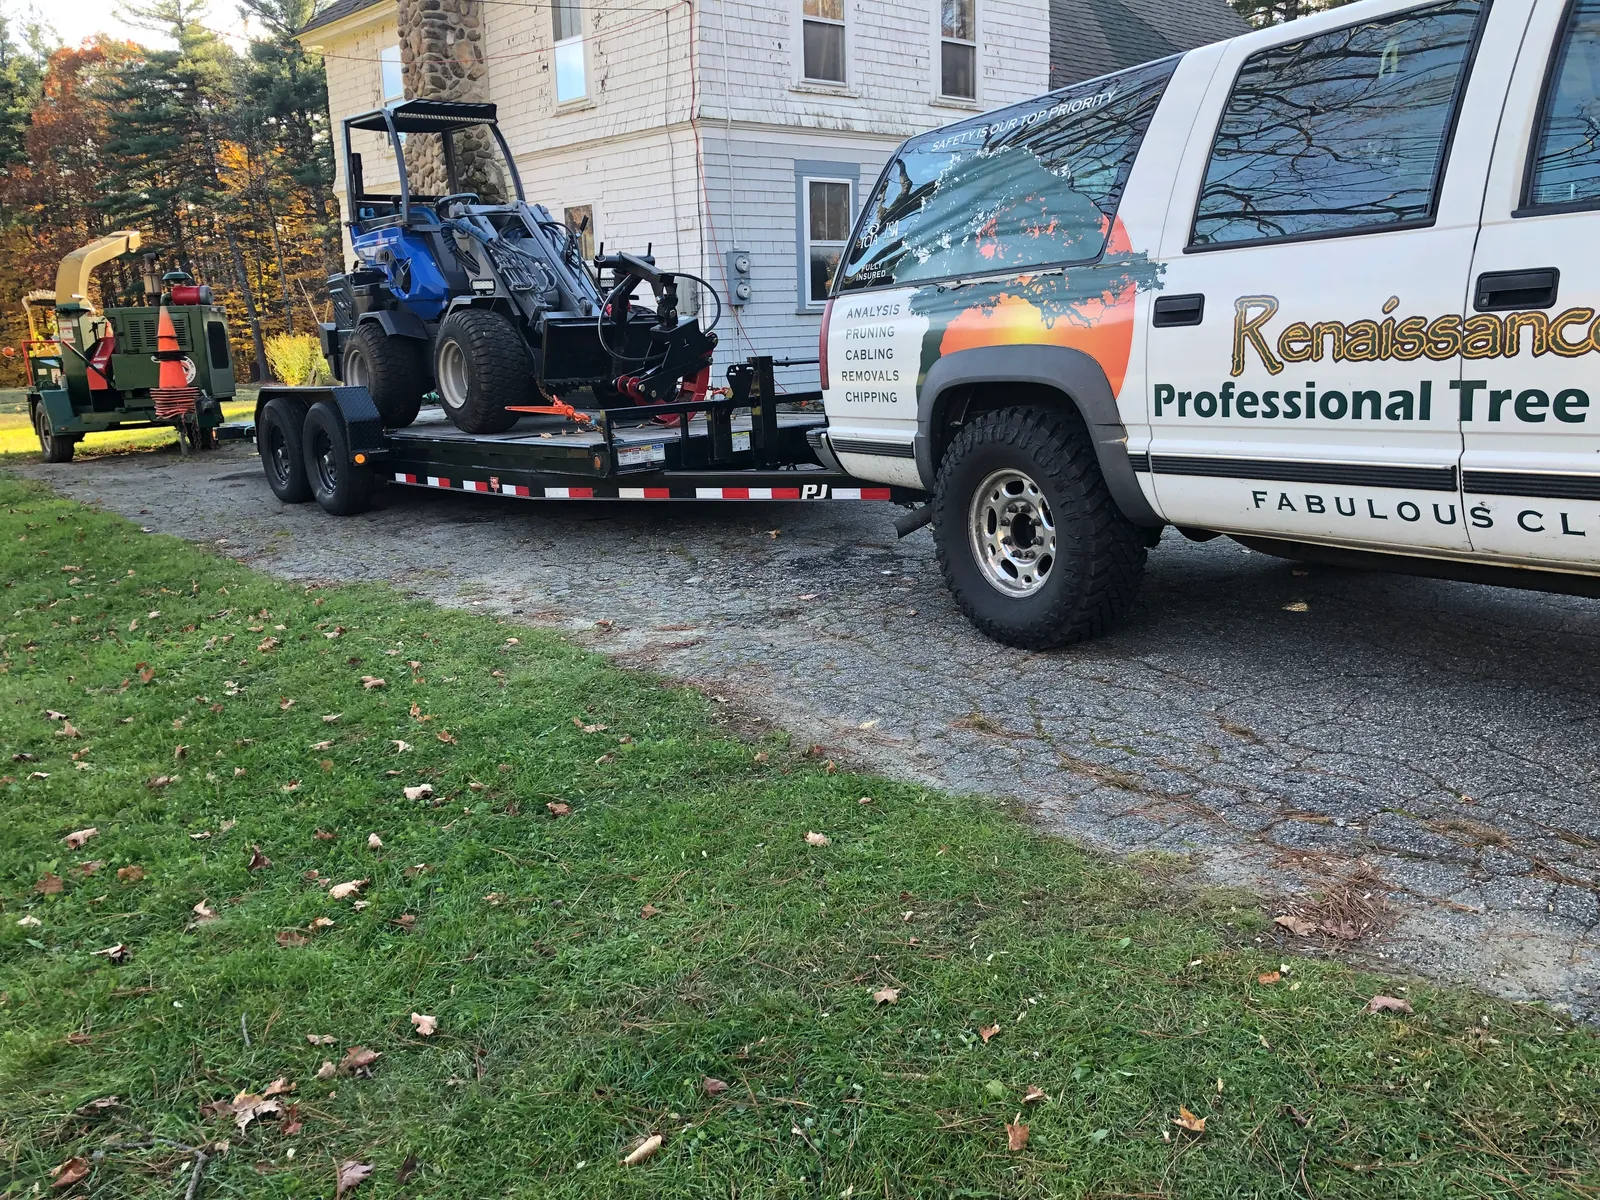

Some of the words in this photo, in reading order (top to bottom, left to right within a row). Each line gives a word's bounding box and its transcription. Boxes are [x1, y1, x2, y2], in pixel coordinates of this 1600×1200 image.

[932, 130, 978, 152] SAFETY
[977, 126, 989, 139] IS
[990, 117, 1019, 136] OUR
[1020, 109, 1048, 127] TOP
[1049, 90, 1117, 119] PRIORITY
[861, 261, 882, 272] FULLY
[856, 270, 886, 282] INSURED
[846, 304, 900, 319] ANALYSIS
[845, 325, 895, 340] PRUNING
[845, 348, 894, 361] CABLING
[841, 370, 900, 381] REMOVALS
[845, 391, 898, 403] CHIPPING
[1153, 380, 1433, 421] Professional
[1449, 379, 1591, 424] Tree
[801, 484, 828, 500] PJ
[1251, 490, 1494, 529] FABULOUS
[1516, 508, 1600, 538] CL
